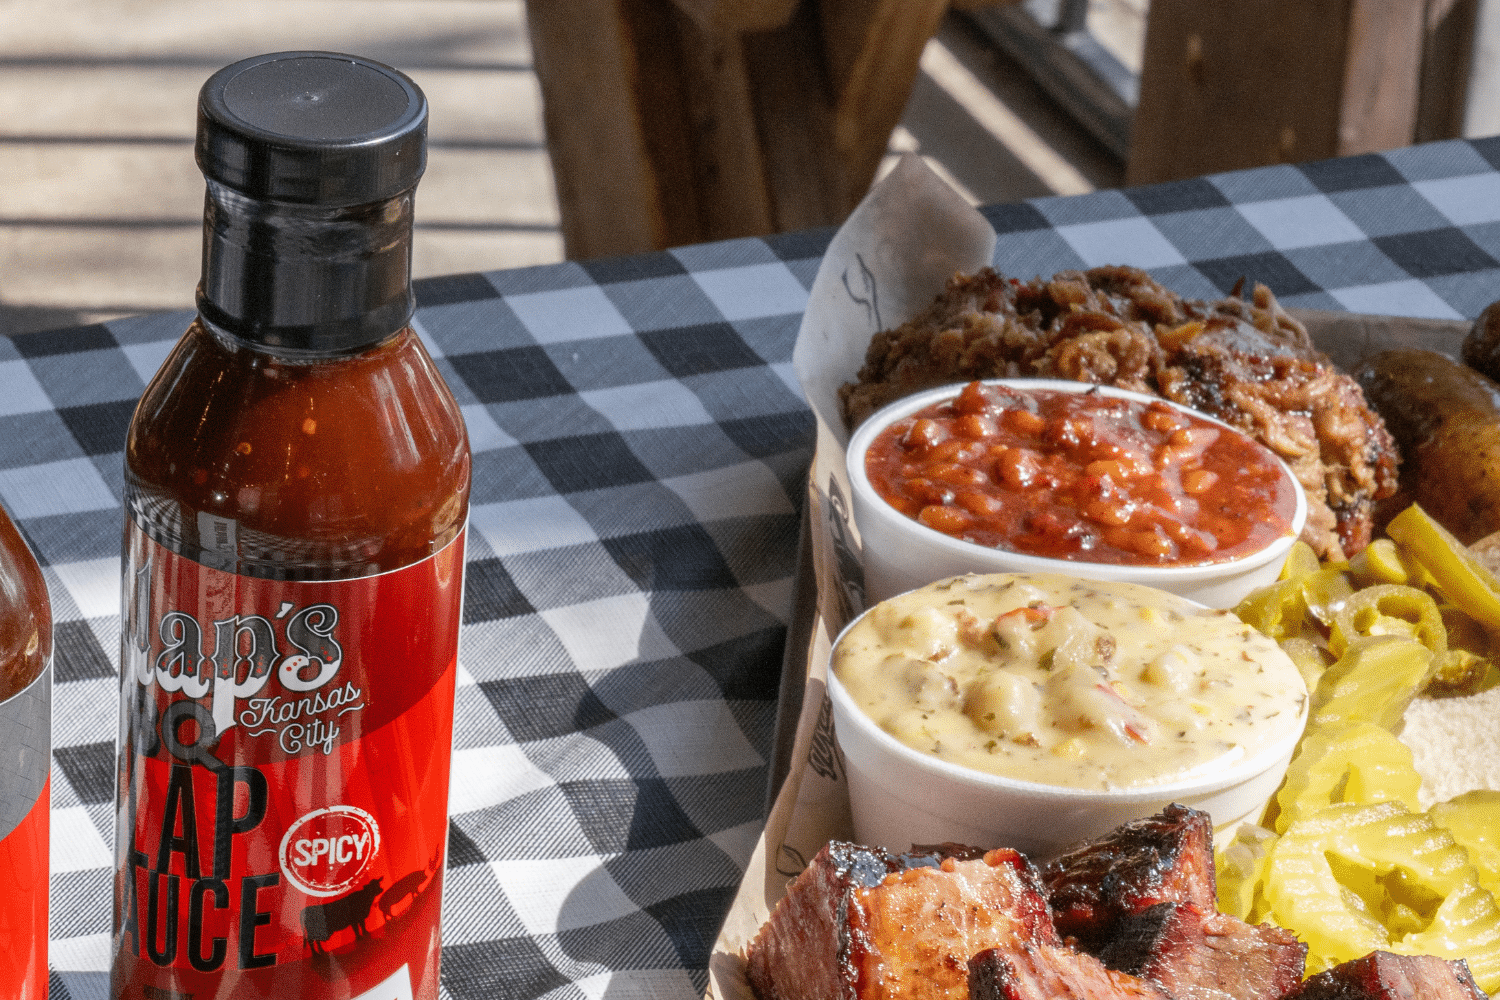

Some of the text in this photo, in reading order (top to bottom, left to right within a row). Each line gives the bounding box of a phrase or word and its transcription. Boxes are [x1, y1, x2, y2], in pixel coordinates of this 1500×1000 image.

[134, 557, 342, 738] lap's
[136, 699, 228, 766] BQ
[240, 681, 362, 727] Kansas
[278, 718, 341, 755] City
[128, 763, 269, 881] LAP
[293, 831, 368, 867] SPICY
[122, 872, 280, 972] AUCE
